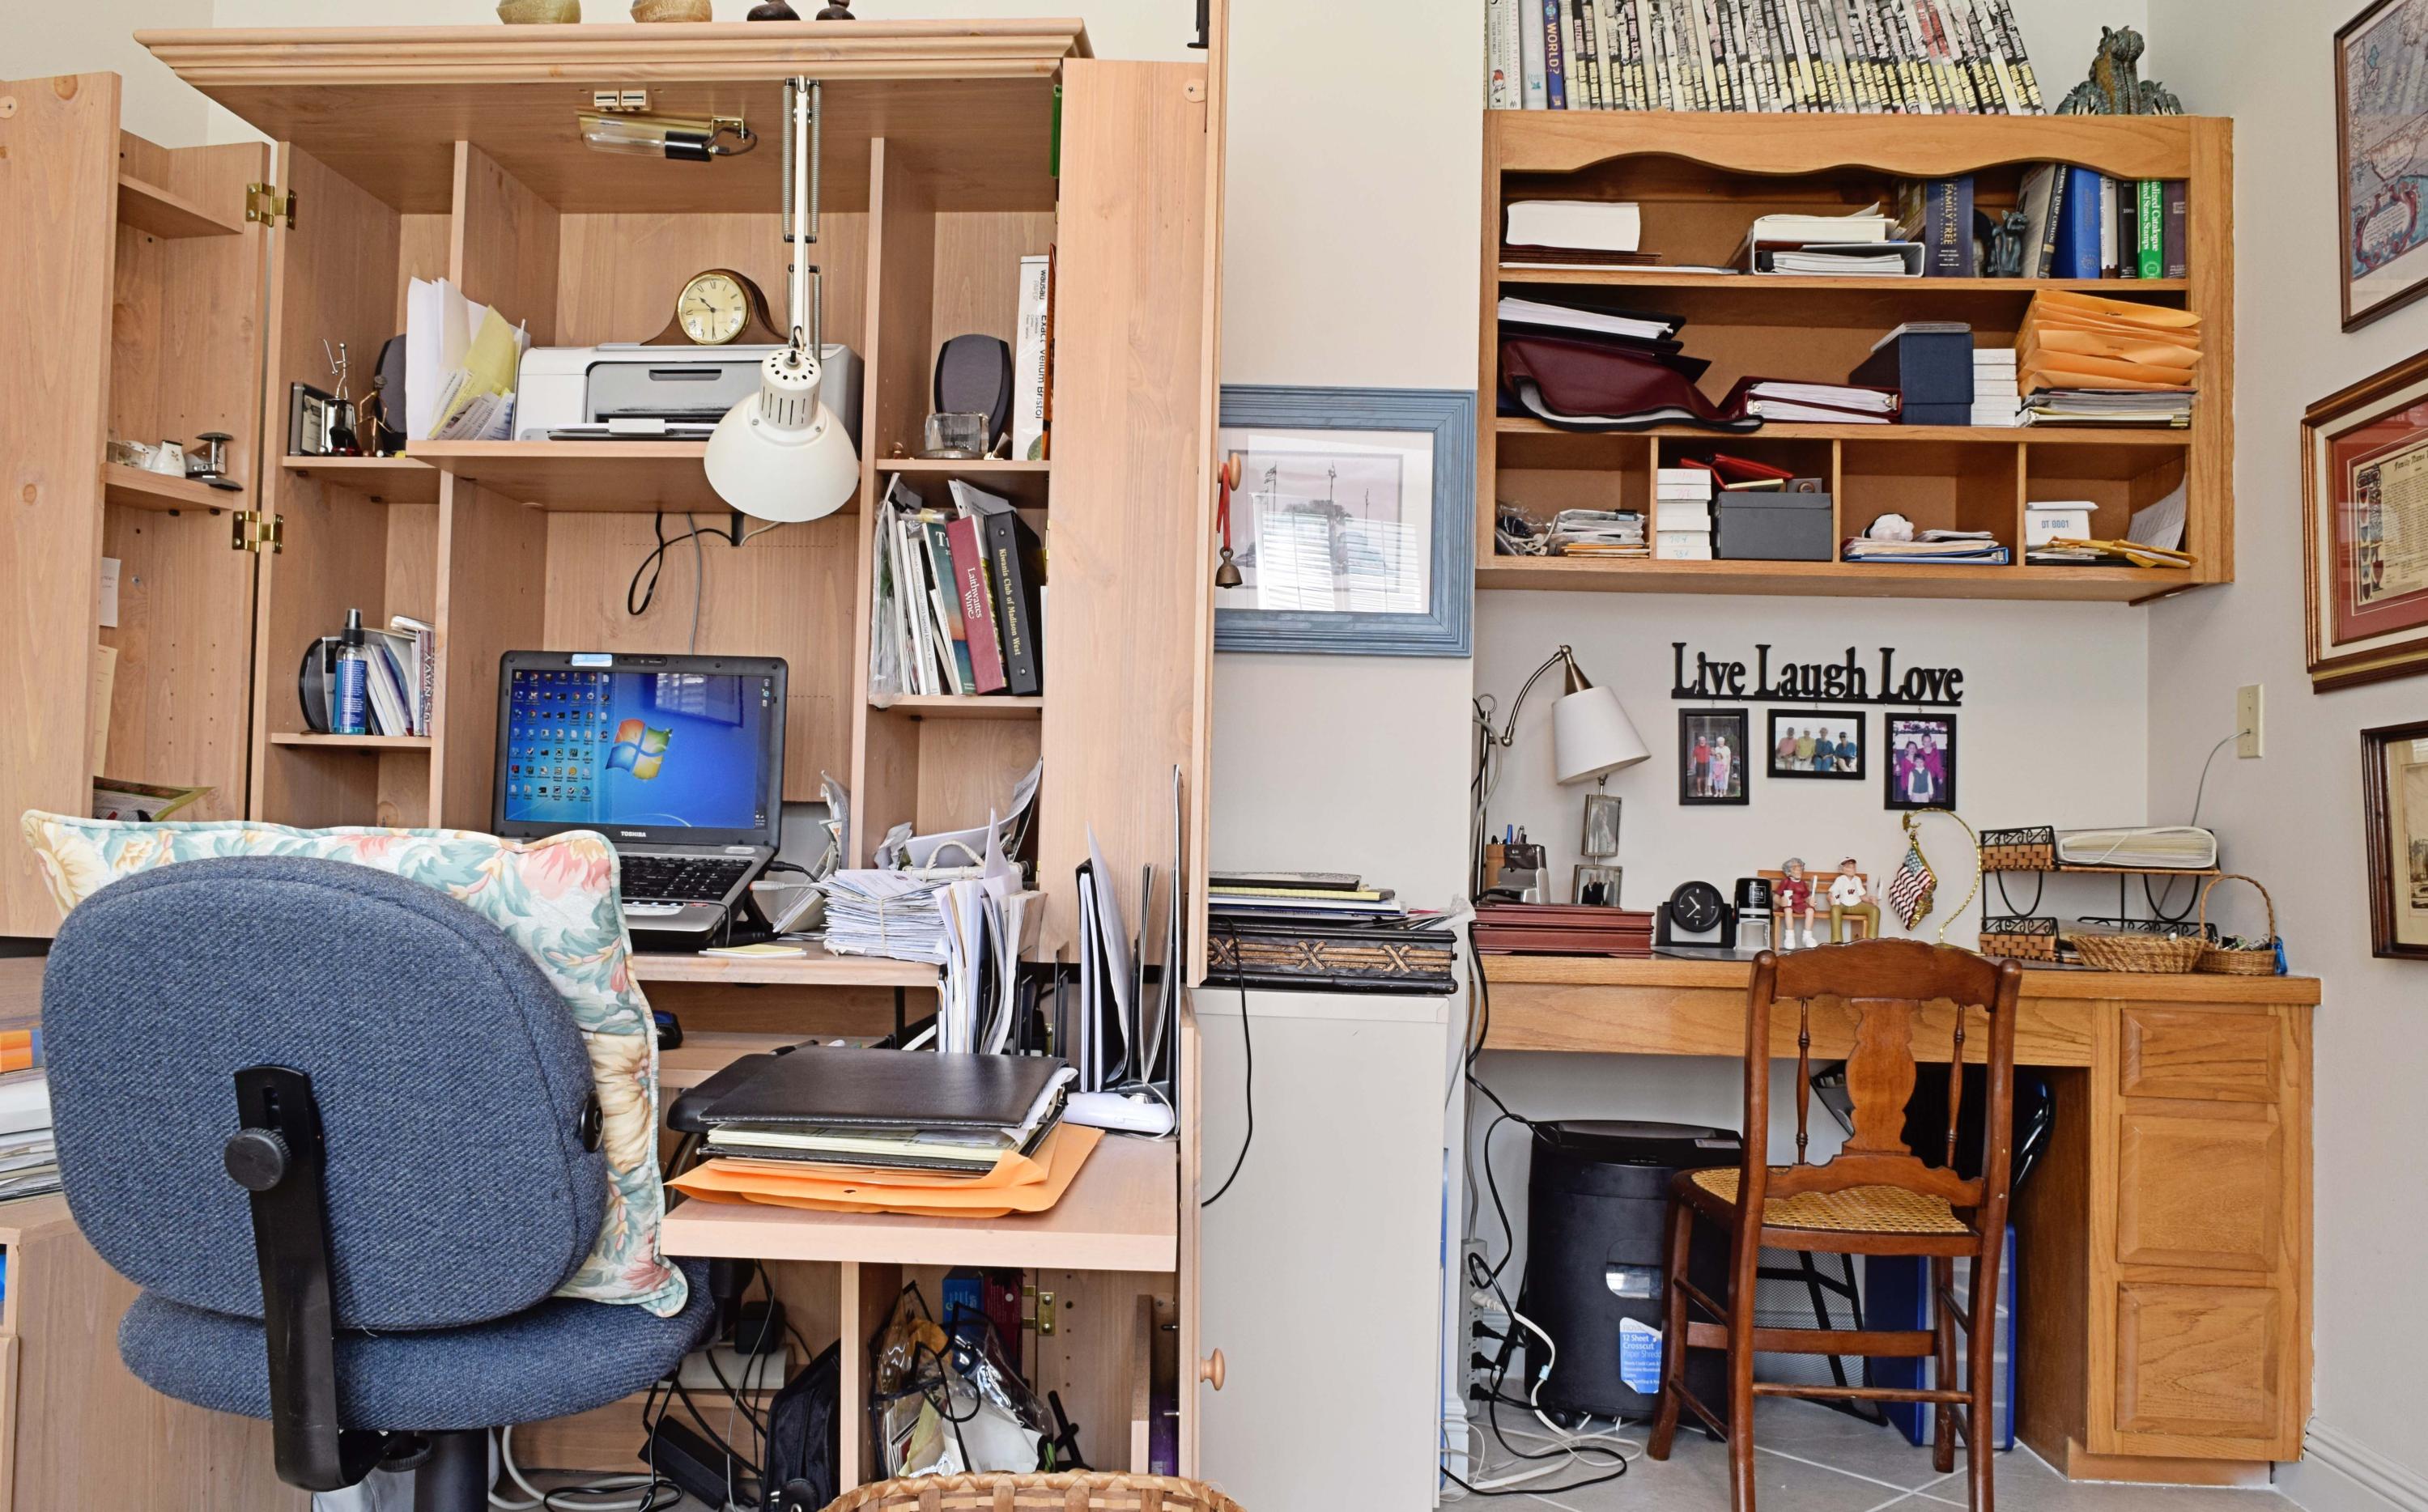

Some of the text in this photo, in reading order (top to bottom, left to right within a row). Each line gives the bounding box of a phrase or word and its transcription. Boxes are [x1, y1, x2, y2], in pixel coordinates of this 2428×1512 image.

[1763, 1, 1772, 11] THE
[1720, 12, 1729, 23] THE
[1766, 13, 1775, 28] ROAD
[1547, 23, 1559, 74] WORLD?
[1588, 62, 1597, 83] WORLD
[1612, 62, 1621, 83] WORLD
[1634, 66, 1643, 87] WORLD
[1812, 61, 1825, 82] WORLD
[1872, 64, 1884, 85] WORLD
[1921, 63, 1933, 84] WORLD
[1935, 65, 1945, 85] WORLD
[1971, 63, 1984, 83] WORLD
[1985, 64, 1996, 85] WORLD
[2021, 65, 2034, 85] WORLD
[1590, 83, 1599, 97] WAR
[1614, 84, 1622, 98] WAR
[1818, 83, 1828, 96] WAR
[1877, 85, 1888, 99] WAR
[1885, 65, 1895, 86] WORLD
[1890, 86, 1900, 100] WAR
[1925, 84, 1937, 98] WAR
[1938, 85, 1950, 99] WAR
[1977, 83, 1988, 97] WAR
[1989, 85, 2001, 99] WAR
[2027, 85, 2039, 100] WAR
[1635, 87, 1645, 100] WAR
[1945, 184, 1954, 219] FAMILY
[2048, 165, 2066, 243] MERICAN STAMP CATALOG
[2143, 200, 2151, 221] States
[2151, 181, 2161, 251] ialized Catalogue
[1944, 221, 1953, 245] TREE
[2141, 223, 2150, 249] Stamps
[999, 549, 1010, 576] Kiwanis
[967, 567, 982, 618] Laithwaites
[1004, 579, 1012, 595] Club
[964, 591, 975, 619] Wine
[1008, 606, 1017, 635] Madison
[1013, 637, 1021, 656] West
[1671, 642, 1963, 701] Live Laugh Love
[424, 703, 431, 723] US
